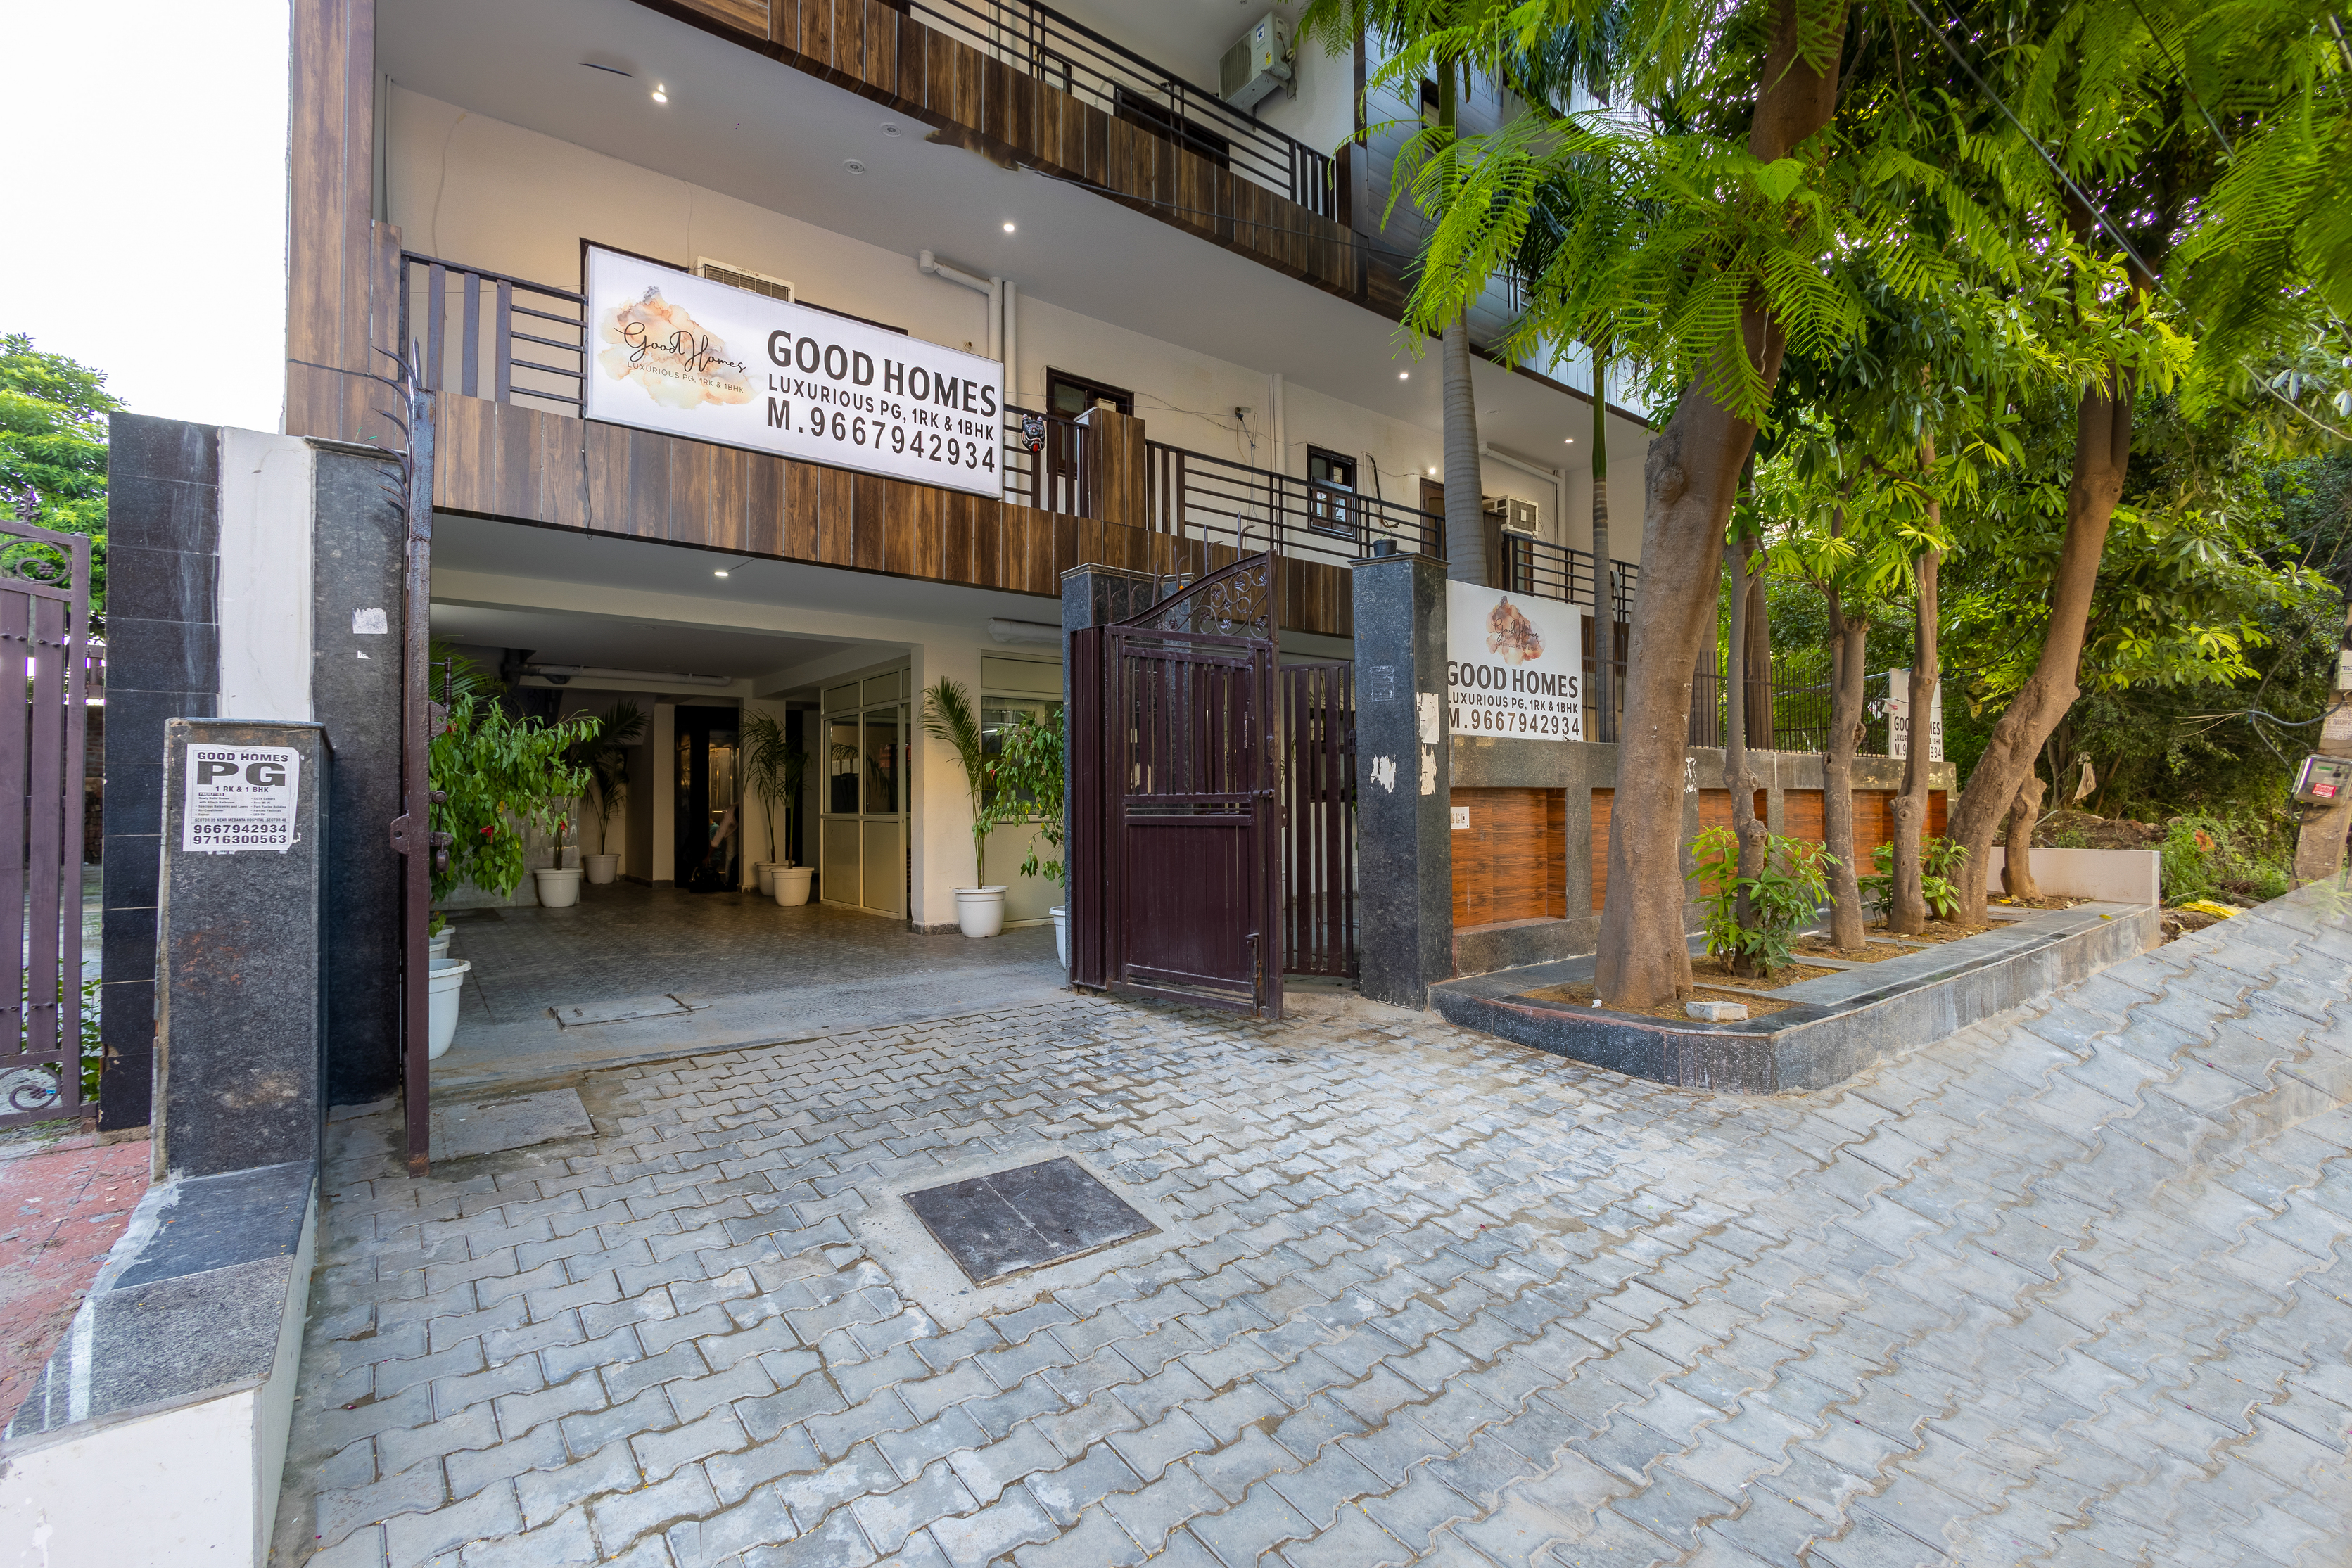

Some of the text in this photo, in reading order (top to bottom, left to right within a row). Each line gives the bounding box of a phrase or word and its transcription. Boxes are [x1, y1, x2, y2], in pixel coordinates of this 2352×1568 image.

[614, 321, 746, 373] Good Homes
[627, 361, 680, 379] LUXURIOUS
[699, 378, 713, 387] 1RK
[724, 383, 744, 393] 1BHK
[768, 329, 996, 417] GOOD HOMES
[769, 373, 994, 441] LUXURIOUS PG, 1RK & 1BHK
[1491, 618, 1515, 642] Good
[1447, 660, 1578, 699] GOOD HOMES
[1511, 697, 1527, 711] PG,
[1530, 699, 1546, 711] 1RK
[1549, 701, 1554, 712] &
[1556, 701, 1579, 714] 1BHK
[197, 752, 288, 762] GOOD HOMES
[193, 824, 287, 834] 9667942934
[193, 835, 286, 844] 9716300563
